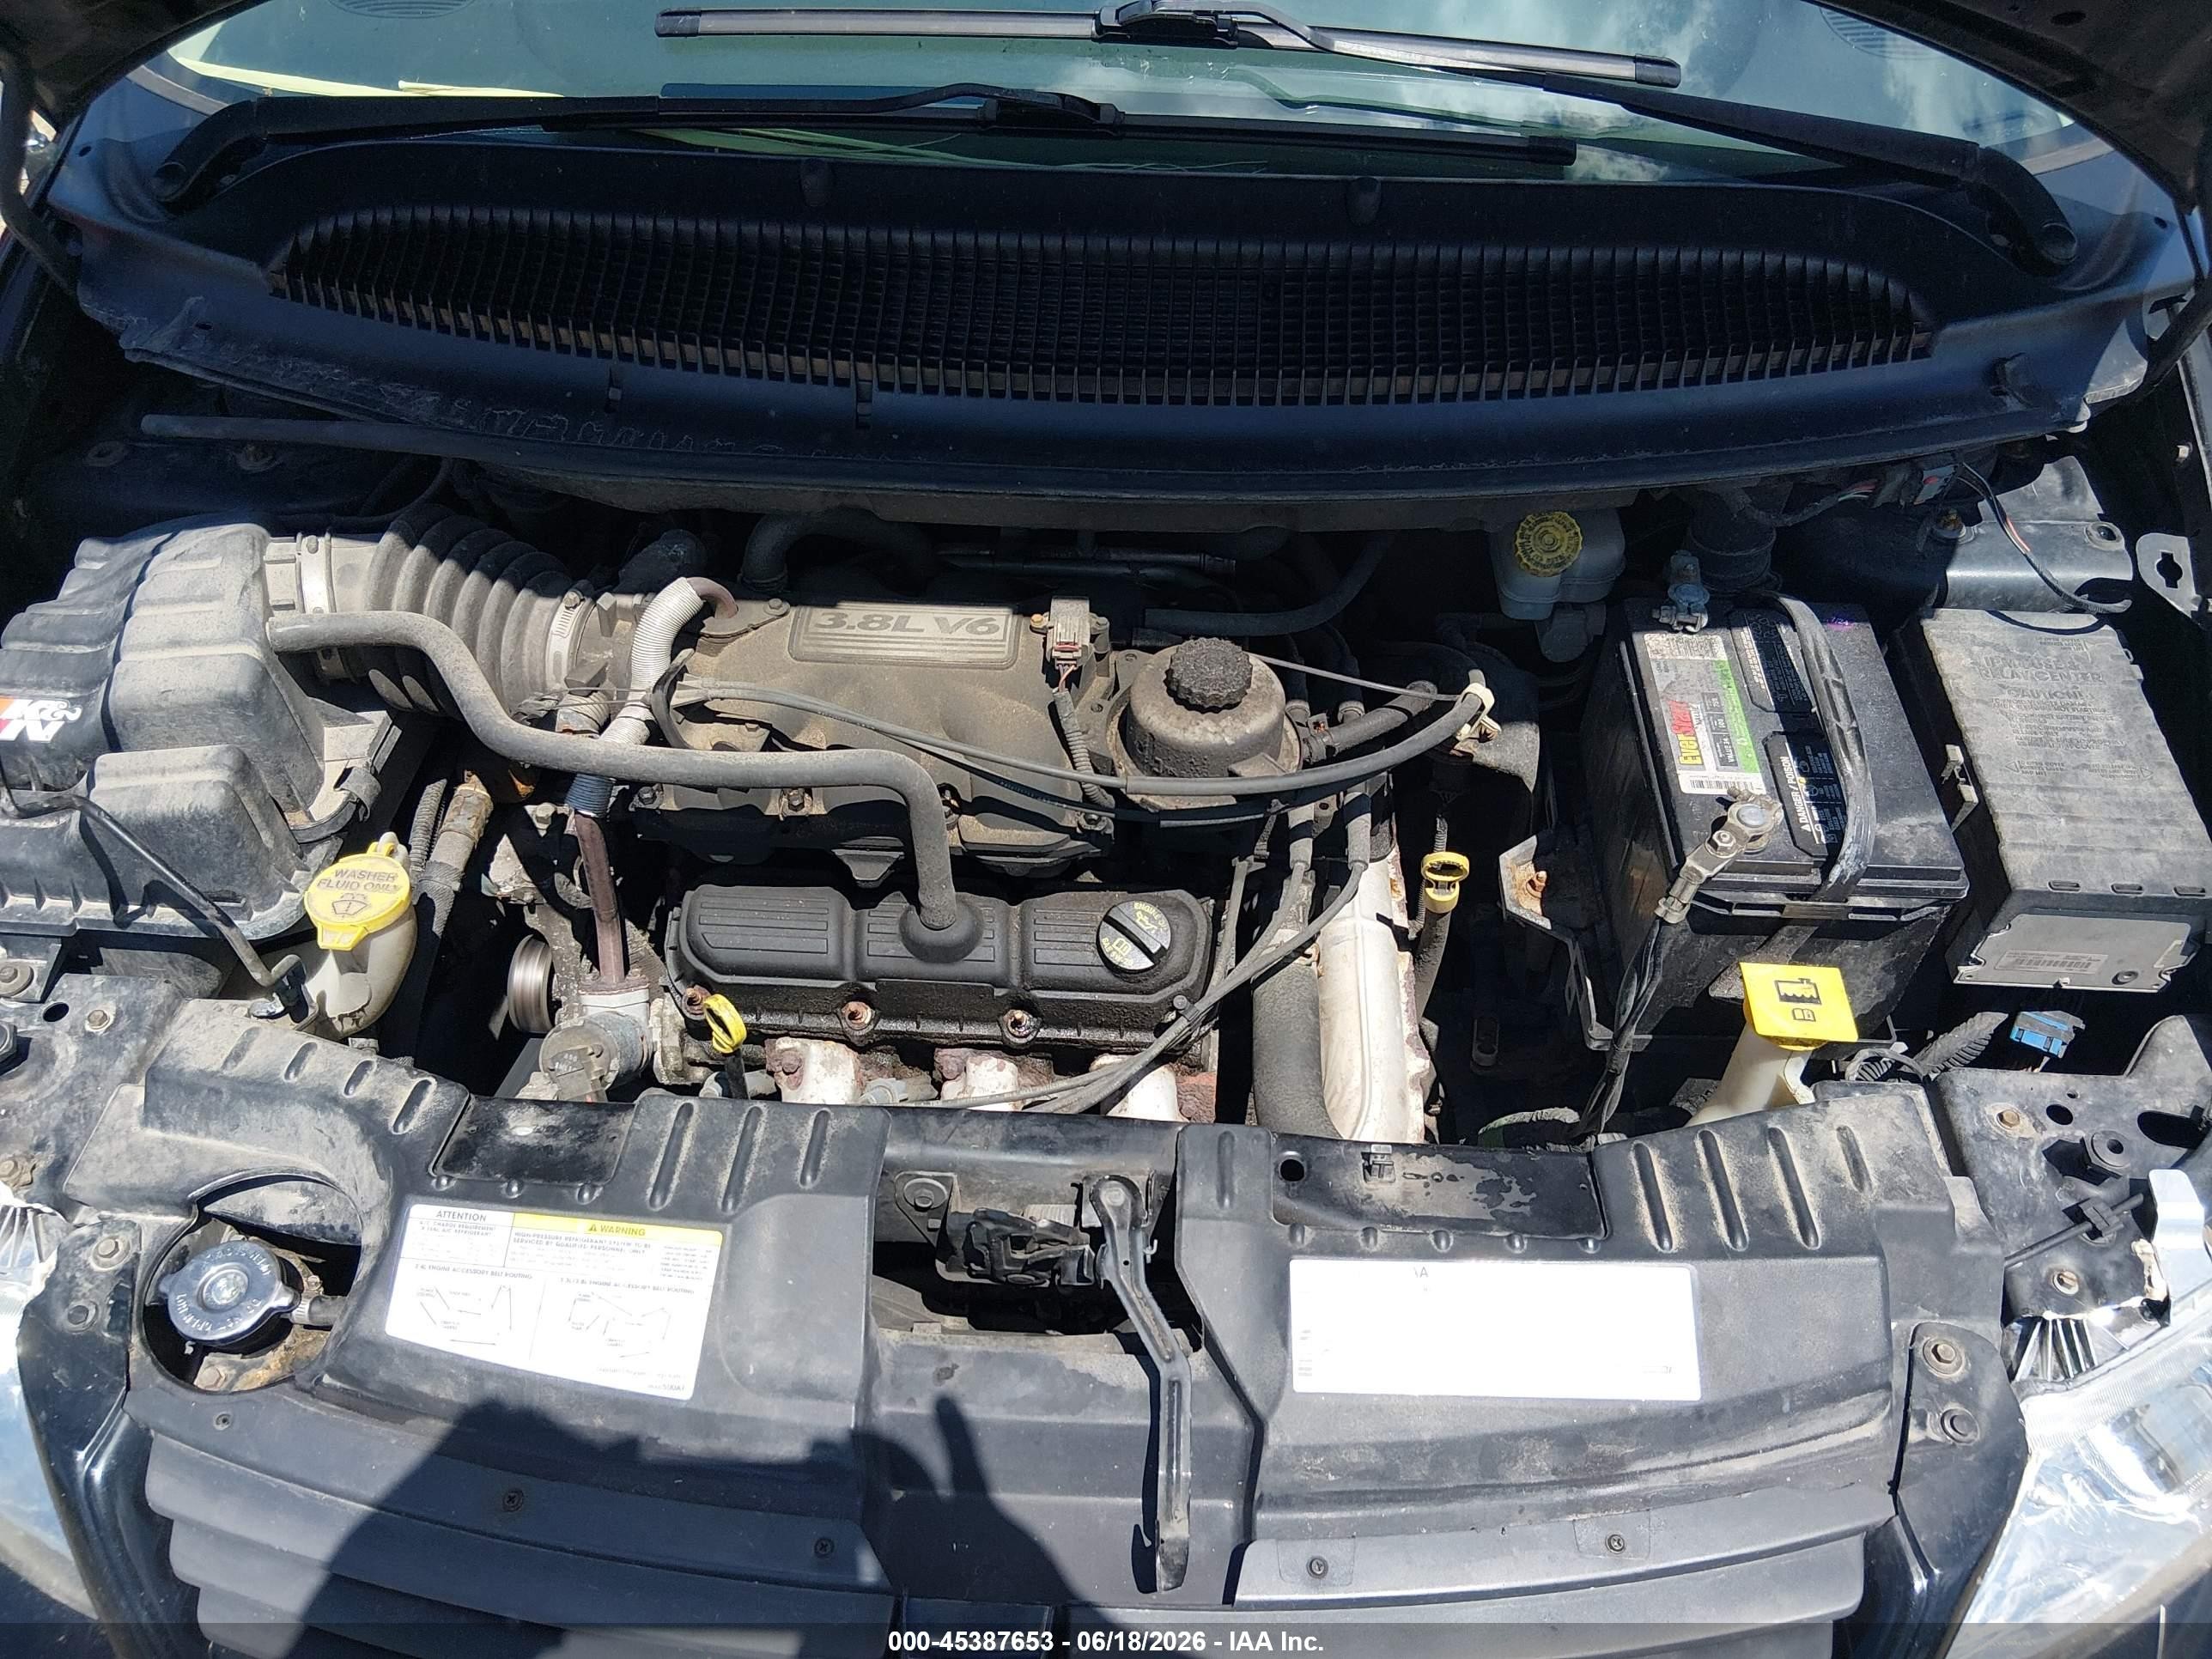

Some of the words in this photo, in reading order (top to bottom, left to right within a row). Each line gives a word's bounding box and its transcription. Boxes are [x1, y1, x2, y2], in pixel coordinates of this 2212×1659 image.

[815, 612, 924, 633] 3.8L
[933, 617, 1000, 635] V6
[1780, 757, 1796, 784] POISON
[1791, 791, 1809, 823] DANGER
[335, 869, 398, 883] WASHER
[317, 878, 361, 890] FLUID
[363, 882, 403, 894] ONLY
[1134, 902, 1160, 921] ENGINE
[435, 1210, 487, 1222] ATTENTION
[600, 1224, 646, 1237] WARNING
